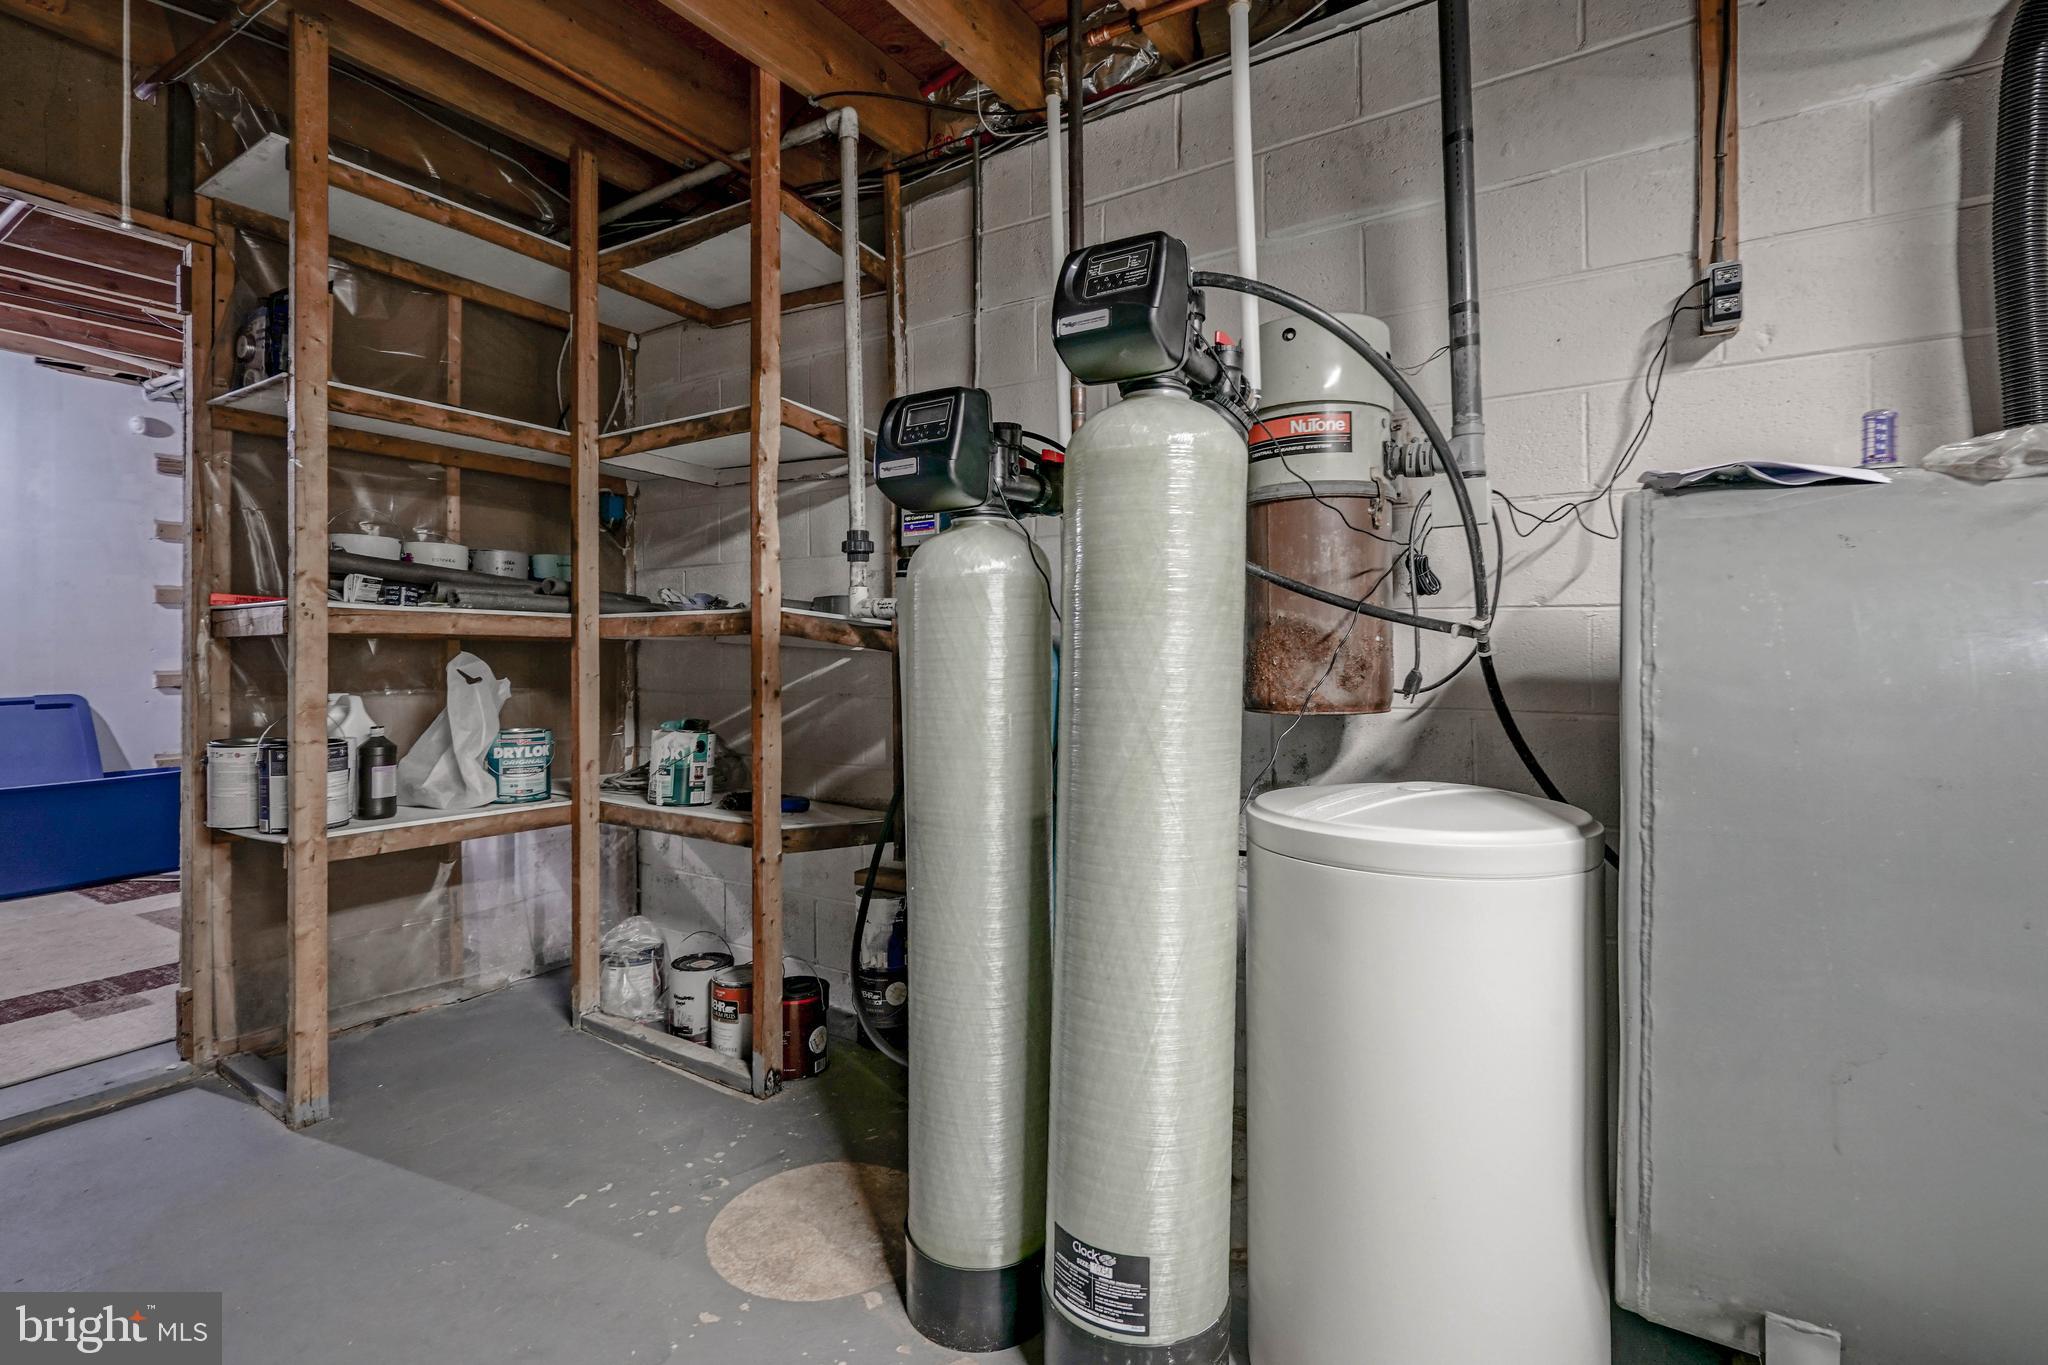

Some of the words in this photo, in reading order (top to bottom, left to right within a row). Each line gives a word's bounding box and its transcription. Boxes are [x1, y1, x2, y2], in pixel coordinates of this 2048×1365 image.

[1290, 418, 1345, 434] NuTone
[1274, 445, 1304, 453] CEANING
[493, 745, 550, 759] DRYLOK
[503, 758, 544, 766] ORIGINAL
[1072, 1240, 1100, 1264] Clack
